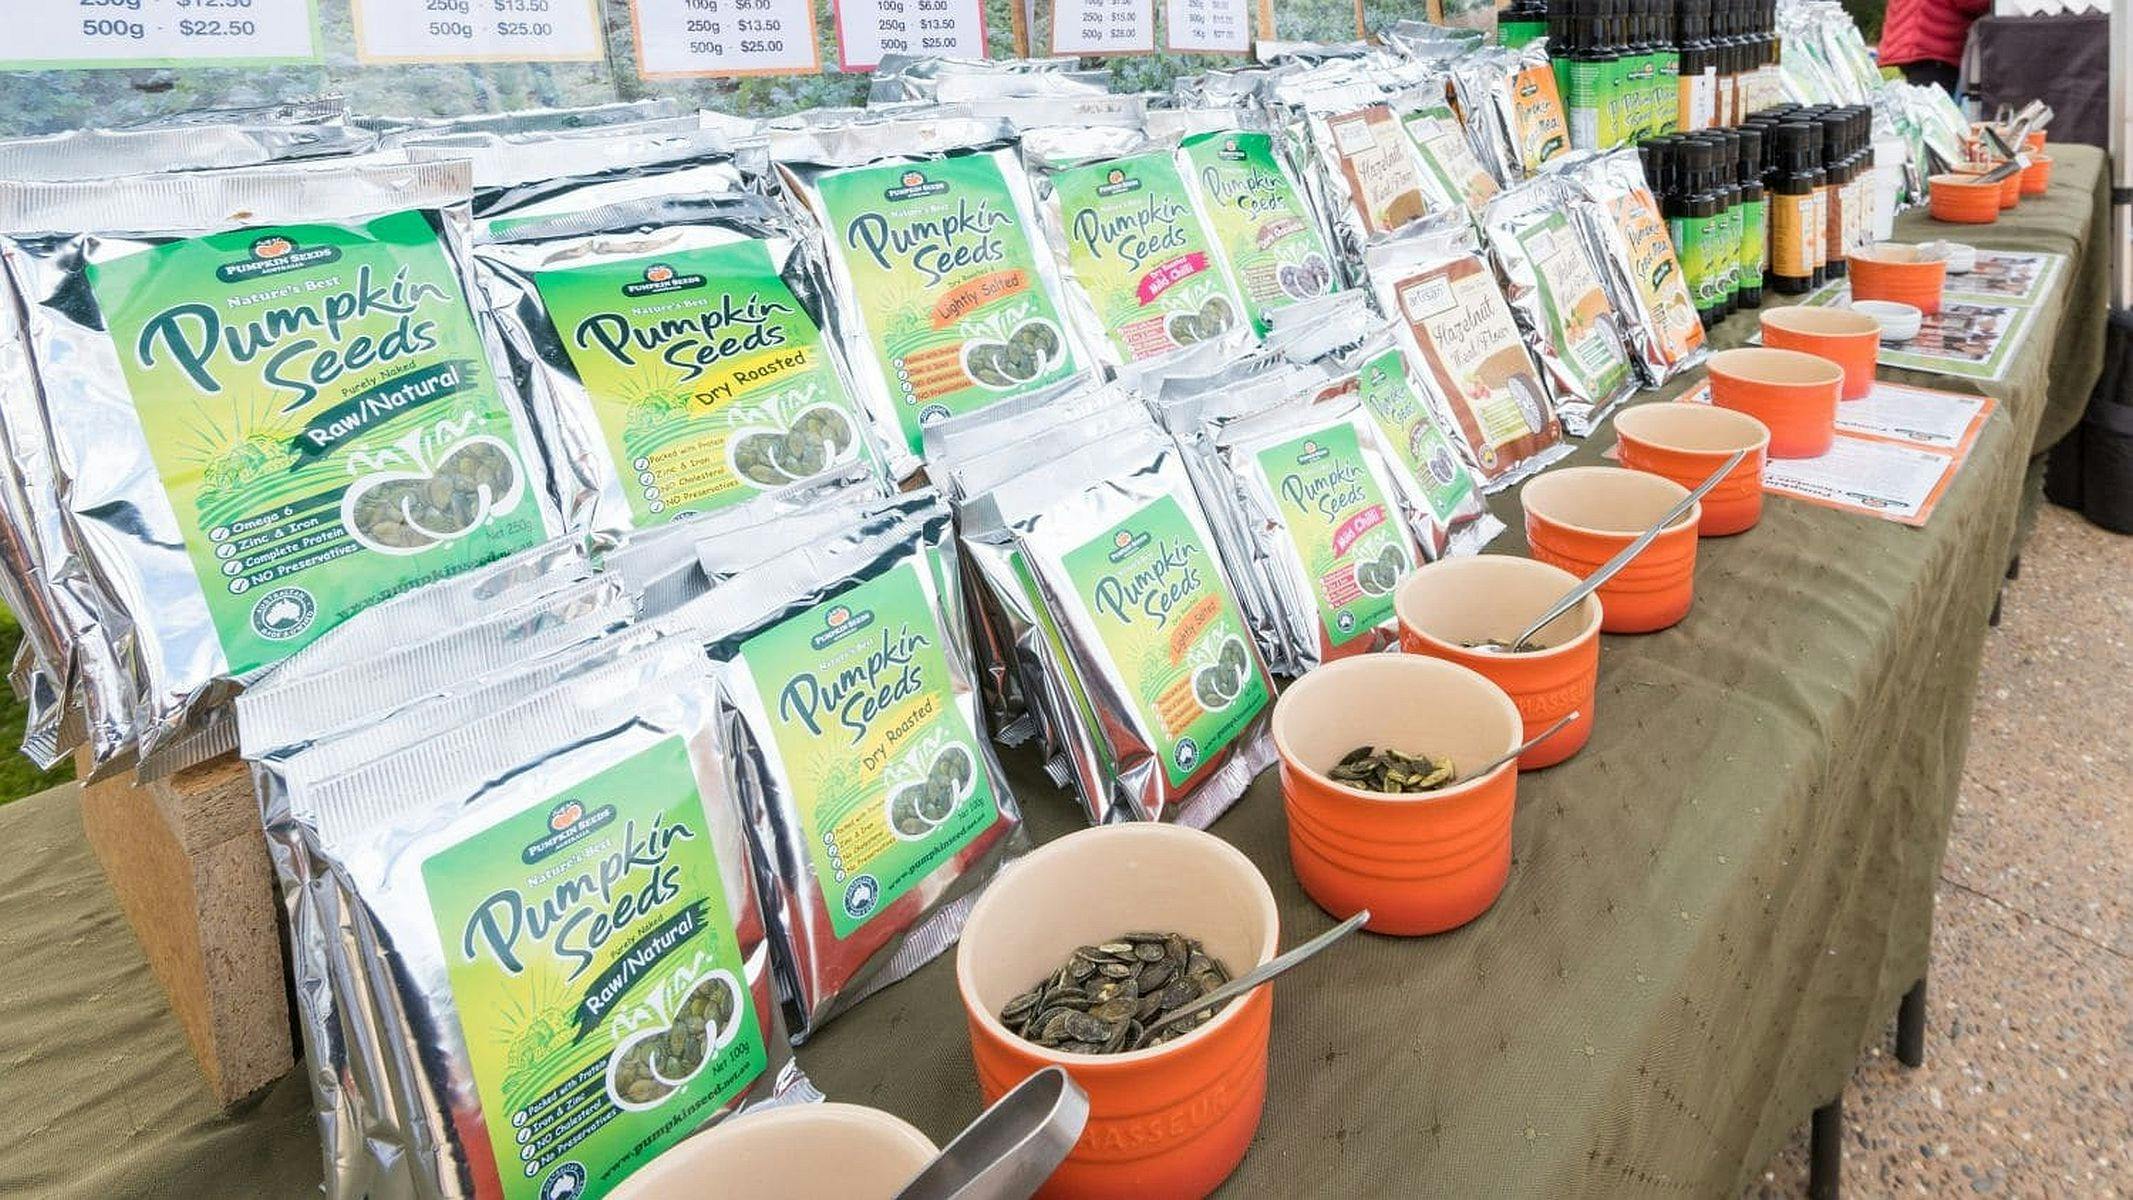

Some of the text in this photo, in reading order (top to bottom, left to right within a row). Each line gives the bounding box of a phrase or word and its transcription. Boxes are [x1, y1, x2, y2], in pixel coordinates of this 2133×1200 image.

[83, 20, 256, 39] 500g $22.50
[687, 20, 781, 35] 250g $13.50
[878, 1, 948, 13] 100g $6.00
[879, 18, 956, 31] 250g $13.50
[429, 22, 553, 38] 500g $25.00
[690, 40, 783, 55] 500g $25.00
[880, 37, 957, 51] 500g $25.00
[1081, 29, 1102, 40] 500g
[1202, 165, 1285, 208] Pumpkin
[1237, 194, 1286, 221] Seeds
[849, 199, 1013, 270] Pumpkin
[1073, 192, 1189, 259] Pumpkin
[225, 248, 332, 276] PUMPKIN SEEDS
[913, 237, 1004, 289] Seeds
[1118, 226, 1187, 273] Seeds
[226, 275, 342, 308] Nature's Best
[937, 273, 1020, 319] Lightly Salted
[138, 264, 451, 392] Pumpkin
[576, 294, 794, 365] Pumpkin
[1432, 295, 1495, 349] Hazelnut
[264, 315, 438, 413] Seeds
[664, 324, 786, 382] Seeds
[340, 377, 377, 398] Purely
[695, 351, 806, 406] Dry Roasted
[307, 365, 462, 447] Raw/Natural
[1282, 459, 1364, 514] Pumpkin
[1319, 485, 1366, 524] Seeds
[232, 506, 294, 533] Omega 6
[238, 534, 270, 550] Zinc
[289, 518, 320, 533] Iron
[246, 527, 344, 567] Complete Protein
[251, 543, 359, 585] NO Preservatives
[1095, 539, 1200, 624] Pumpkin
[1144, 569, 1202, 630] Seeds
[780, 625, 931, 736] Pumpkin
[841, 665, 922, 745] Seeds
[862, 699, 933, 773] Dry Roasted
[528, 825, 578, 857] PUMPKIN
[527, 851, 582, 888] Nature's
[464, 813, 696, 974] Pumpkin
[553, 864, 680, 983] Seeds
[585, 911, 694, 1015] Raw/Natural
[730, 1040, 751, 1062] 100g
[528, 1060, 607, 1116] Packed with Protein
[533, 1115, 555, 1132] Iron
[566, 1092, 587, 1110] Zinc
[555, 1099, 602, 1136] Cholesterol
[557, 1108, 618, 1153] Preservatives
[600, 1061, 751, 1181] www.pumpkinseed.net.au
